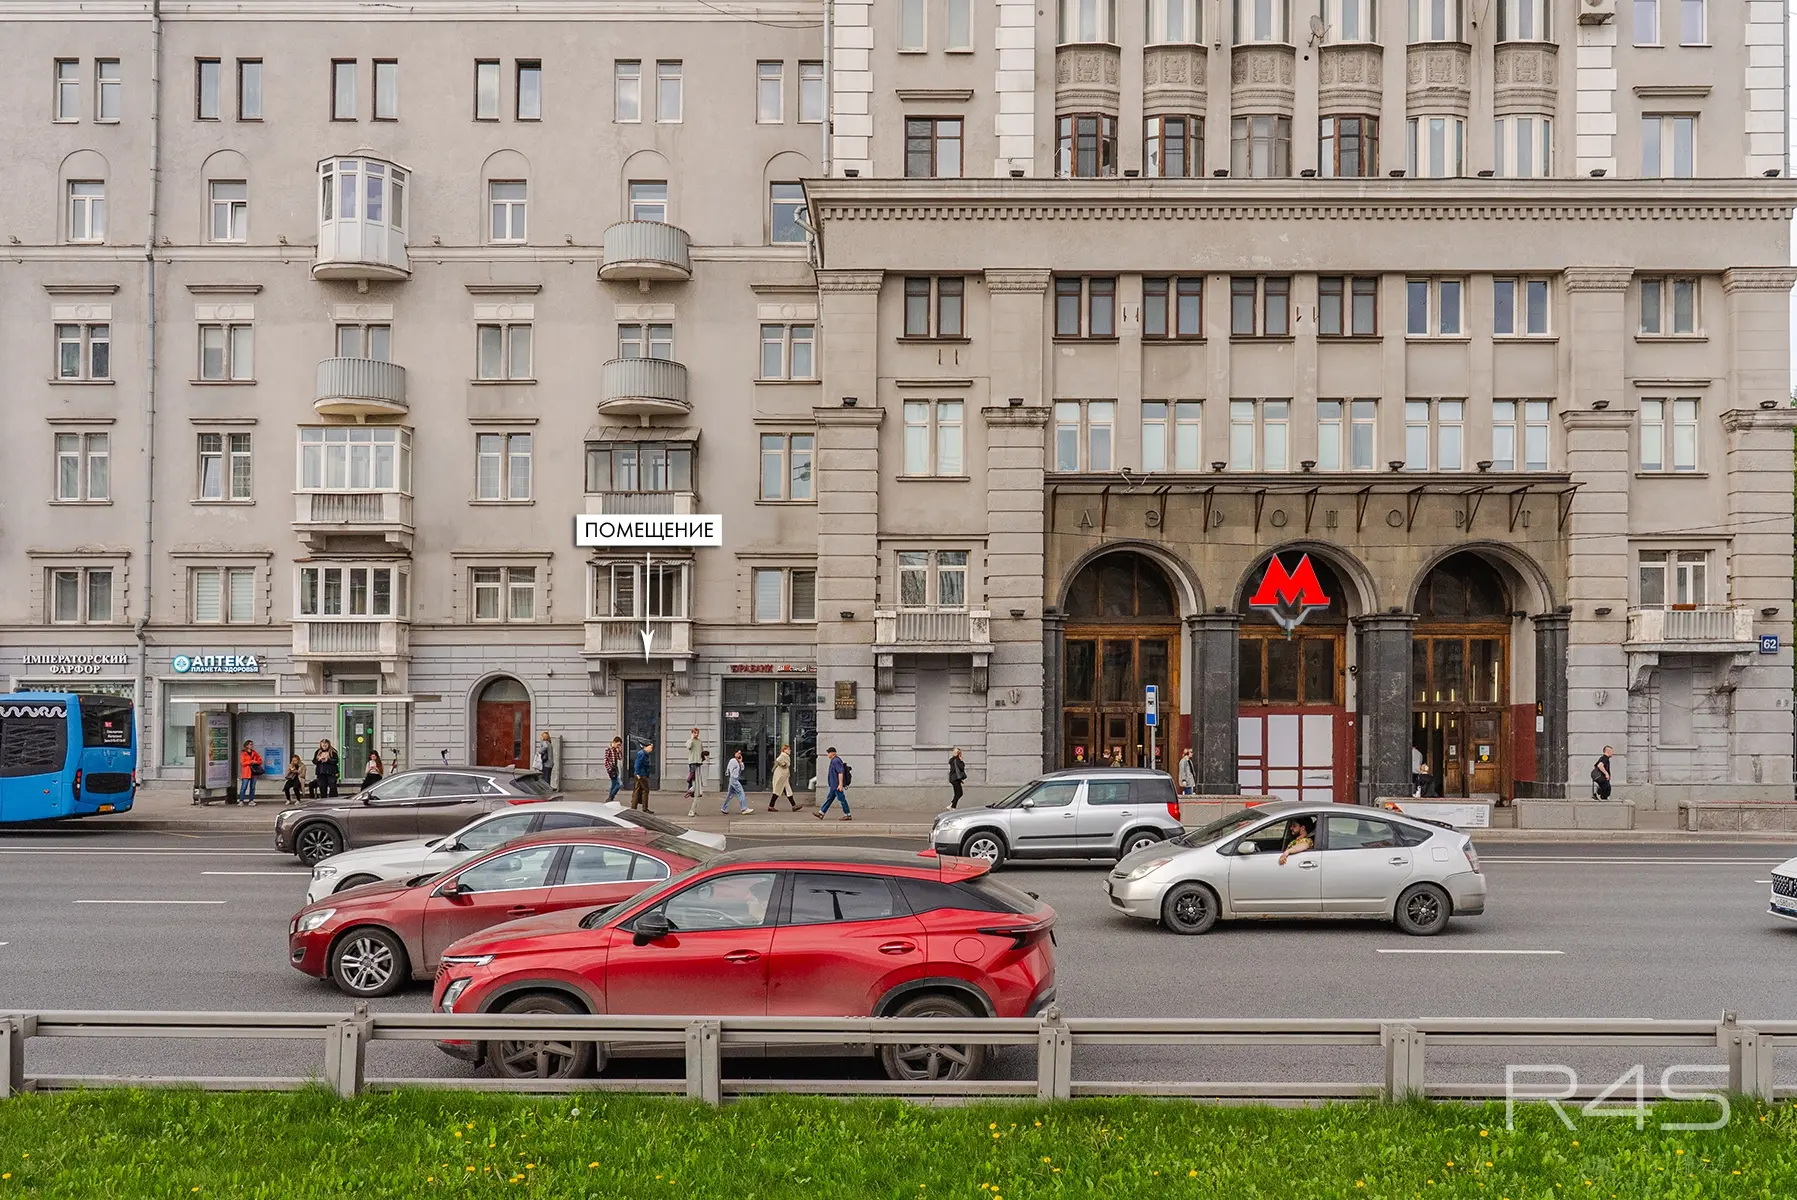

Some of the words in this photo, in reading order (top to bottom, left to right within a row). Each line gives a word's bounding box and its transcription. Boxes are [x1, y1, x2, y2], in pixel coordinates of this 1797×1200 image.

[1763, 639, 1777, 649] 62
[22, 653, 128, 664] ИМПЕРАТОРСКИЙ
[192, 655, 258, 667] АПТЕКА
[49, 664, 101, 674] ФАРФОР
